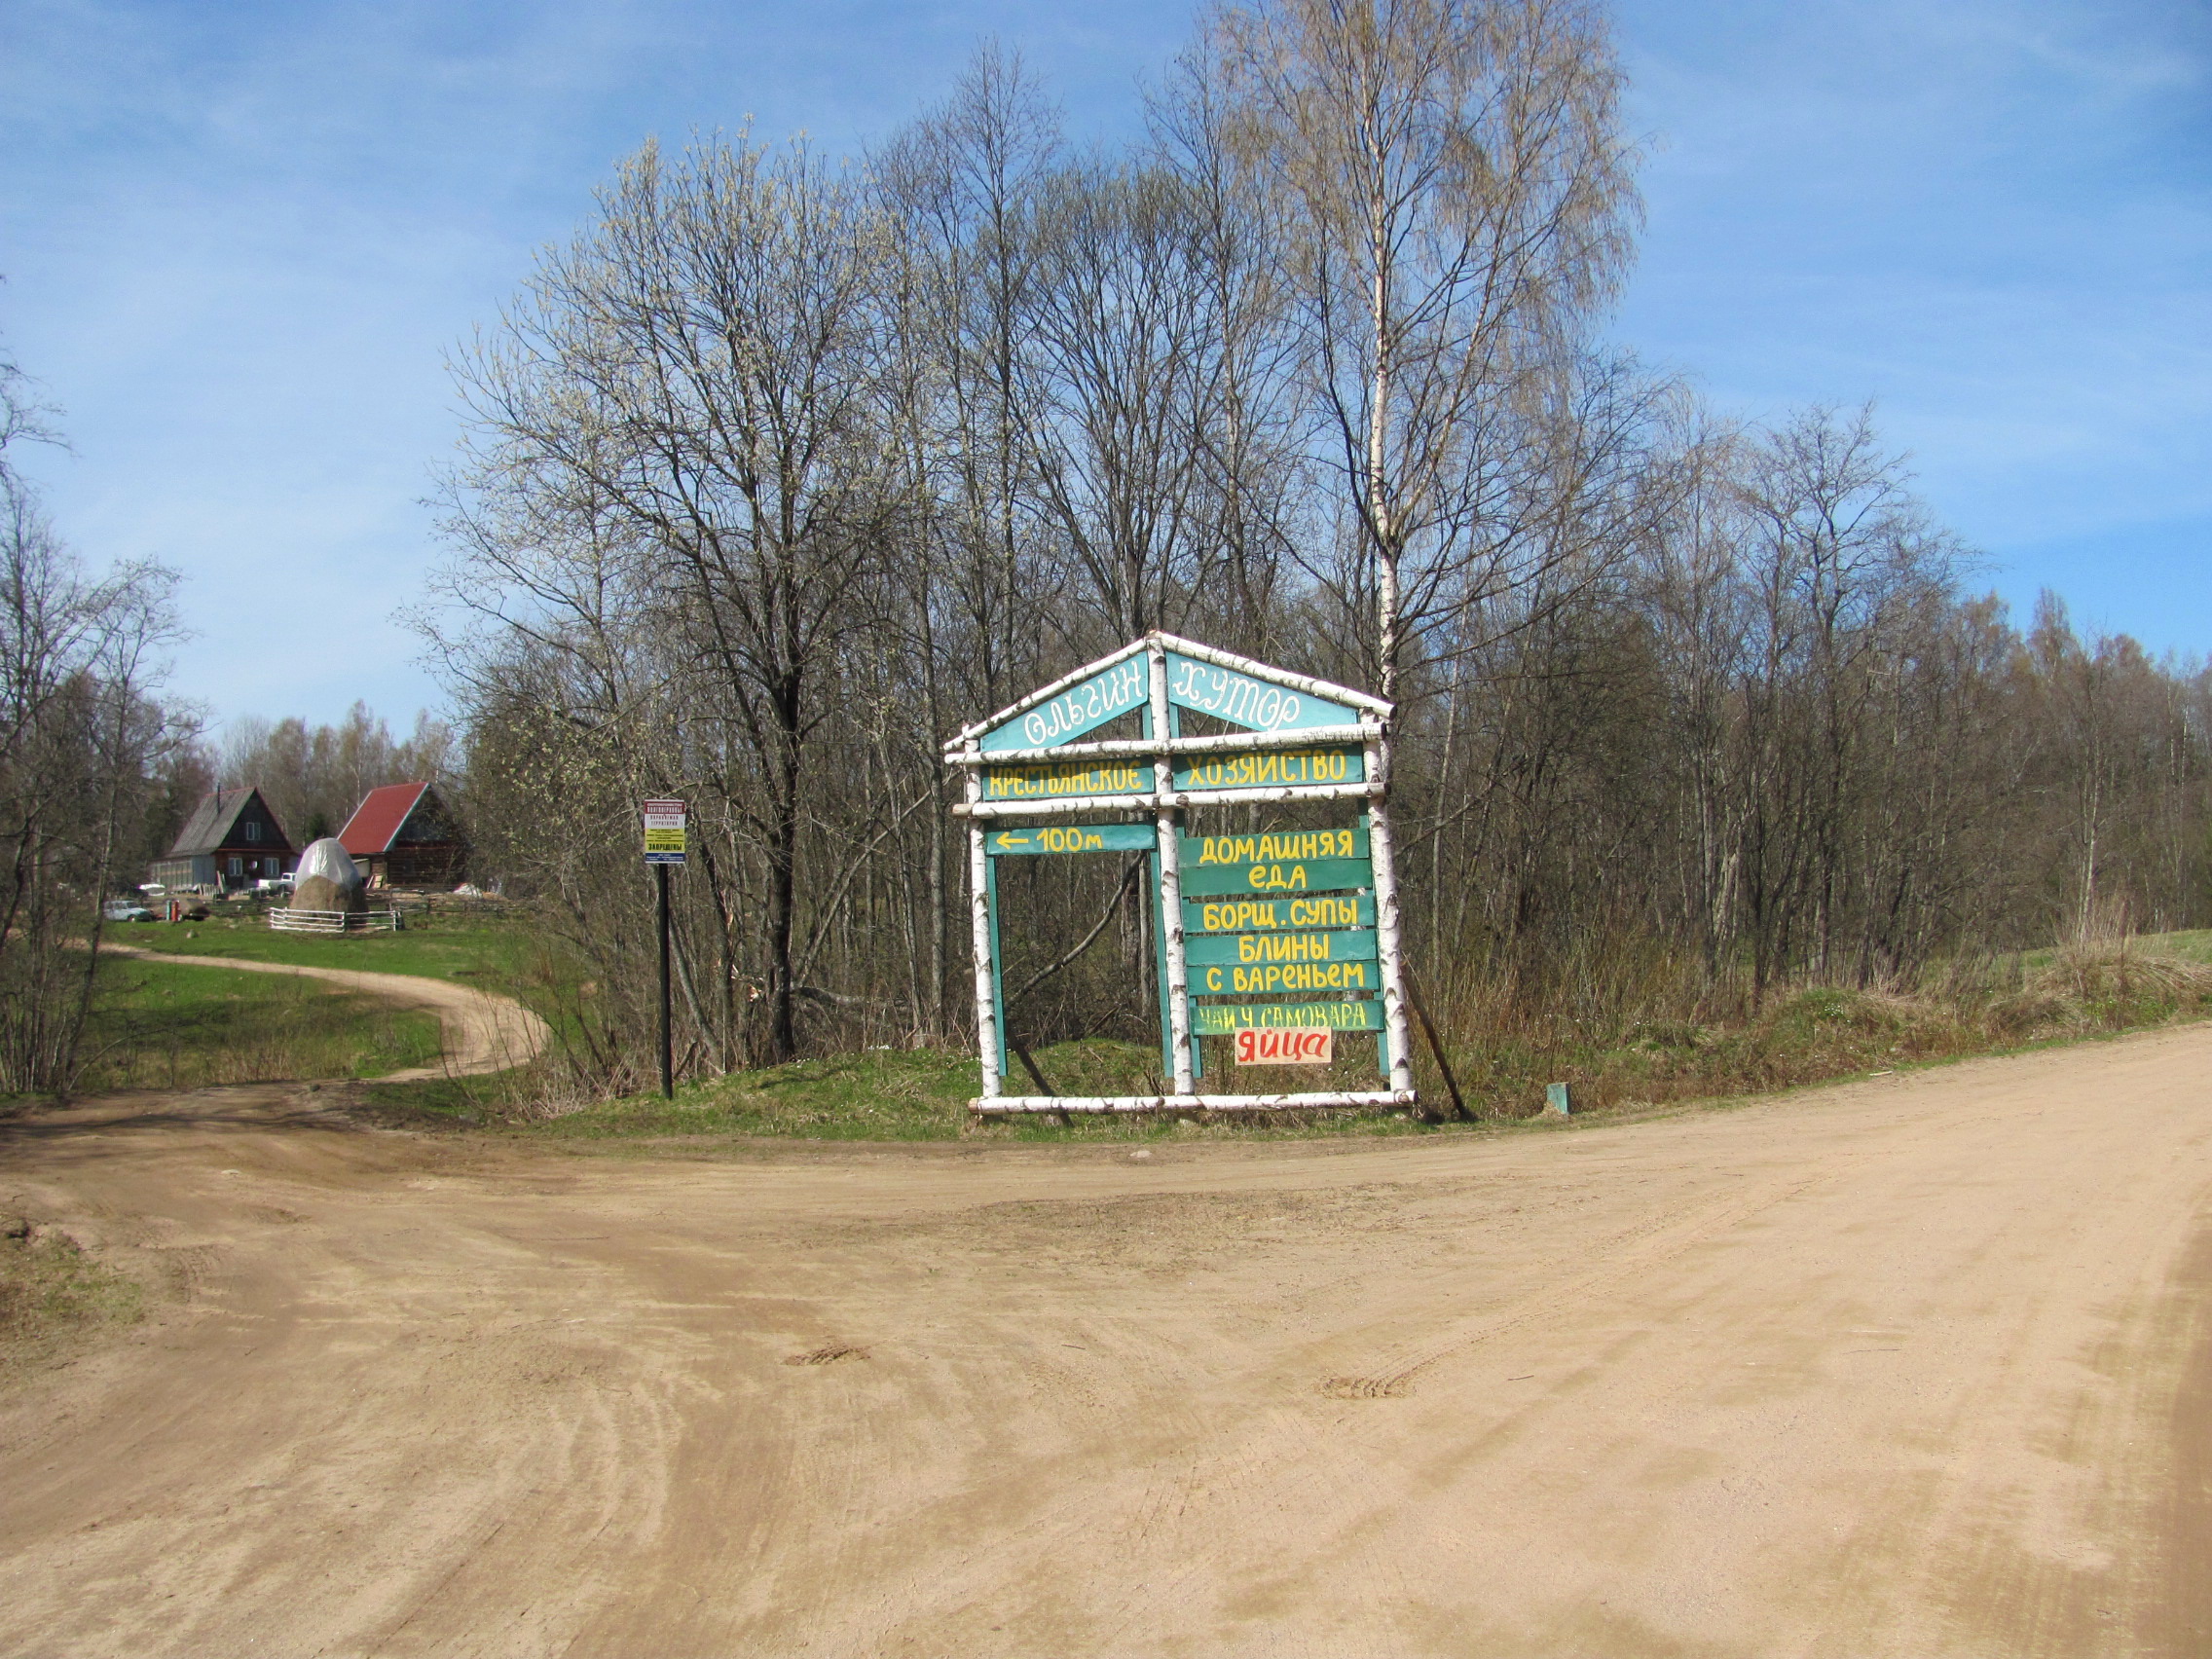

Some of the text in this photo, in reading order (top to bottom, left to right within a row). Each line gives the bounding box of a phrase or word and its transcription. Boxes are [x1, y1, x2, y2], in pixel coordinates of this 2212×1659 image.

[989, 750, 1346, 795] КРЕСТЬЯНСКОЕ ХОЗЯЙСТВО
[1199, 830, 1353, 864] ДОМАШНЯЯ
[1290, 900, 1357, 926] СУПЫ
[1239, 935, 1329, 962] БЛИНЫ
[1207, 968, 1222, 991] С
[1261, 1003, 1366, 1027] САМОВАРА
